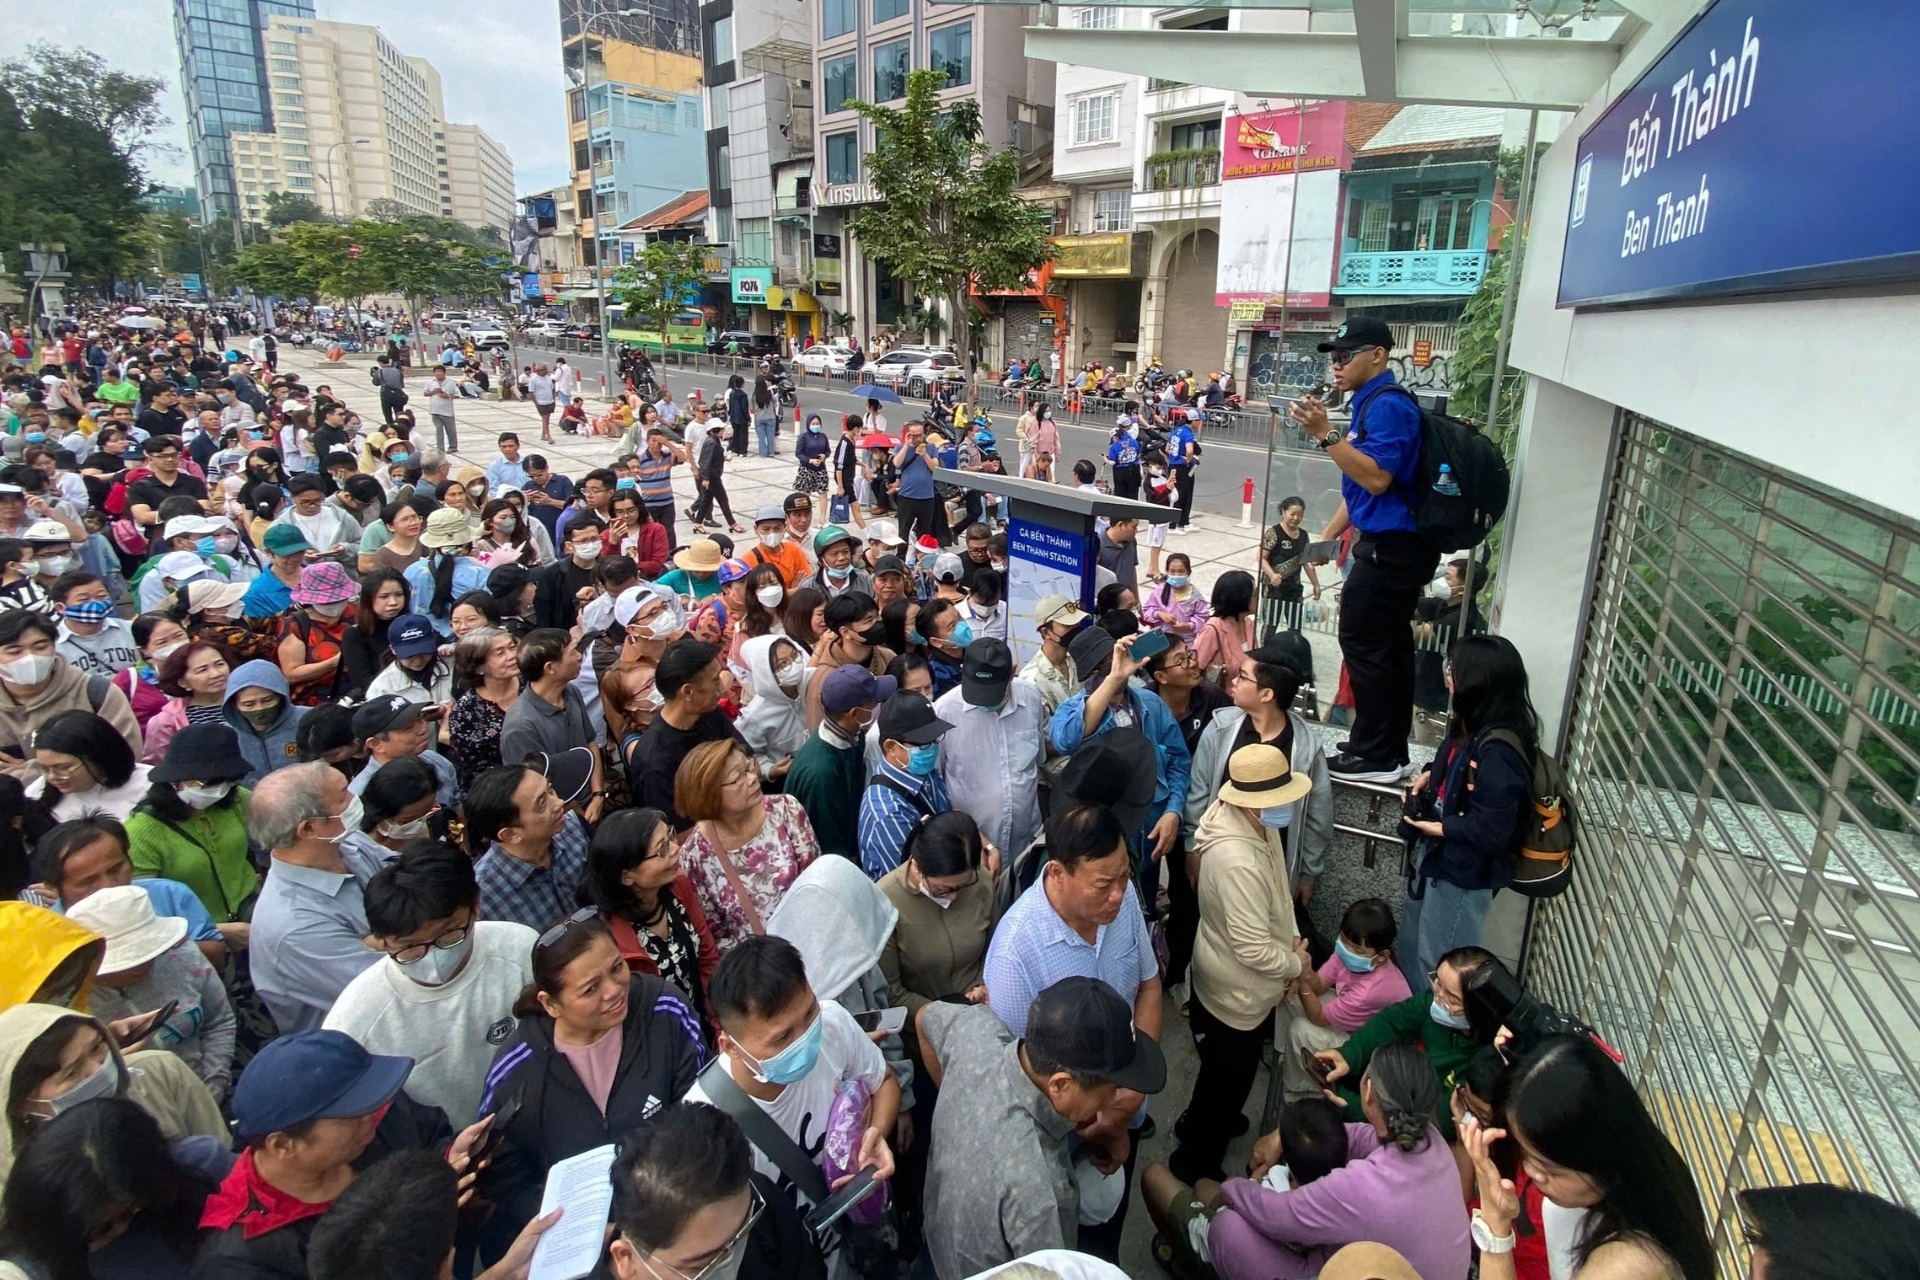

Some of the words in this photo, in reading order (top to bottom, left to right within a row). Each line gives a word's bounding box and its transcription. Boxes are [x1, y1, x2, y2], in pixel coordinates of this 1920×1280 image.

[1620, 92, 1661, 187] Bến
[1666, 16, 1760, 159] Thành
[1620, 210, 1650, 259] Ben
[1652, 173, 1710, 248] Thanh
[1019, 528, 1029, 538] GA
[1031, 530, 1044, 542] BẾN
[1046, 535, 1071, 550] THÀNH
[1013, 541, 1025, 552] BEN
[1026, 545, 1048, 559] THANH
[1050, 551, 1077, 567] STATION
[643, 1103, 662, 1120] adidas
